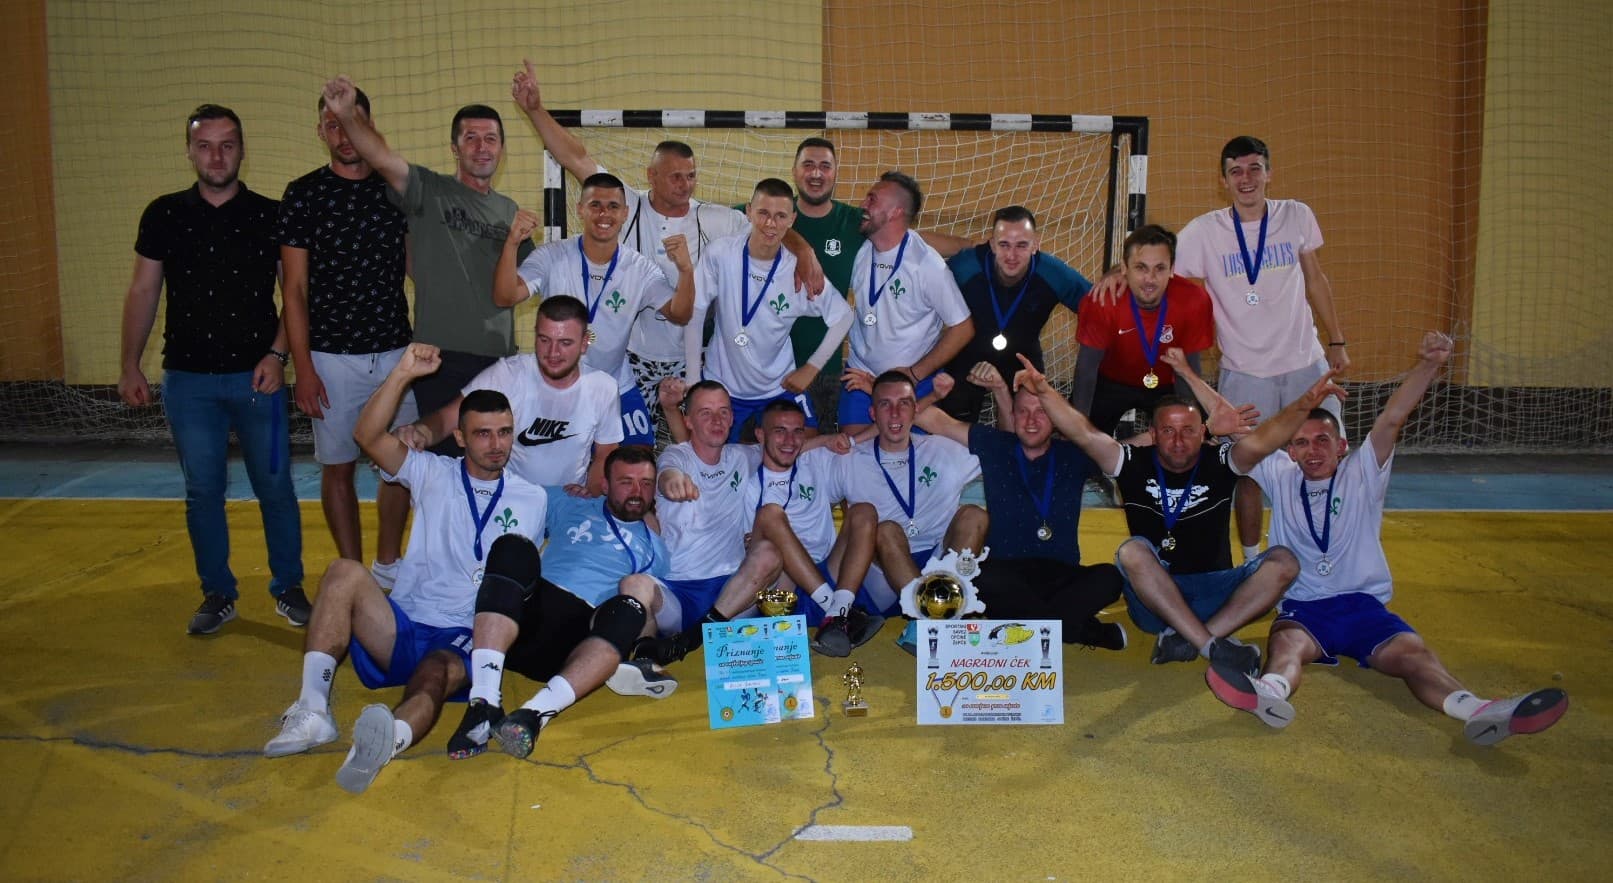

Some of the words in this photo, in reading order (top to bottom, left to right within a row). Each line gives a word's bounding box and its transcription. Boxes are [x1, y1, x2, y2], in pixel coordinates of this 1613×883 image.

[794, 394, 812, 418] 7
[527, 417, 569, 437] NIKE
[623, 409, 649, 436] 10
[950, 658, 1007, 668] NAGRADNI
[1010, 655, 1031, 668] ČEK
[926, 671, 1017, 692] 1.500,00
[1021, 671, 1057, 691] KM
